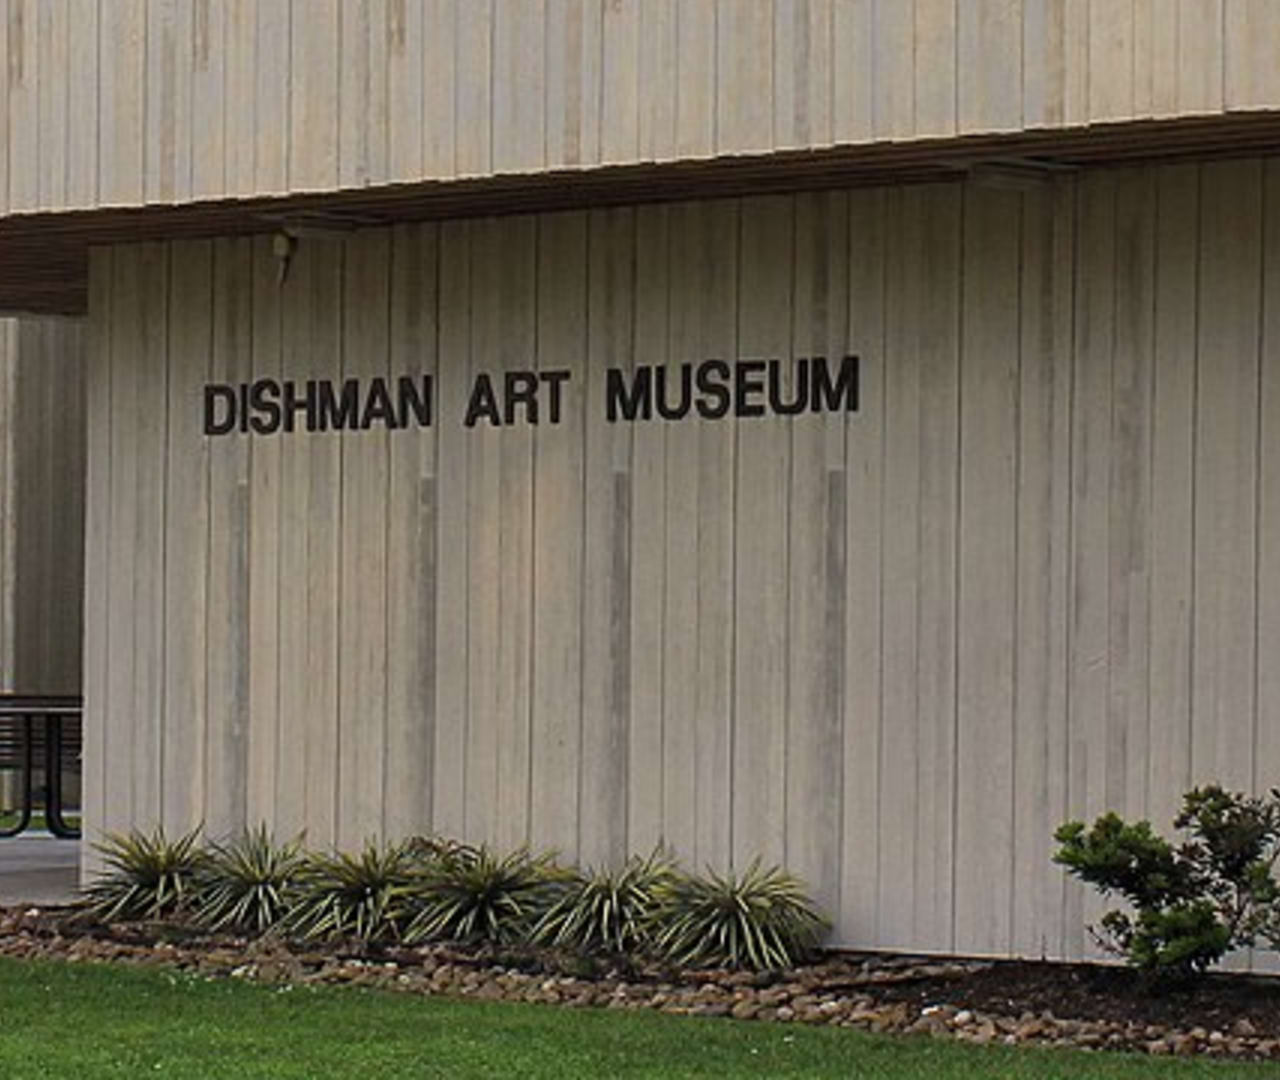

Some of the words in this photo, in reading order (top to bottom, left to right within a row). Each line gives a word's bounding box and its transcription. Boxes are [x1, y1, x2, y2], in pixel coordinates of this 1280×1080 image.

[203, 374, 435, 437] DISHMAN
[463, 370, 572, 429] ART
[604, 356, 861, 423] MUSEUM
